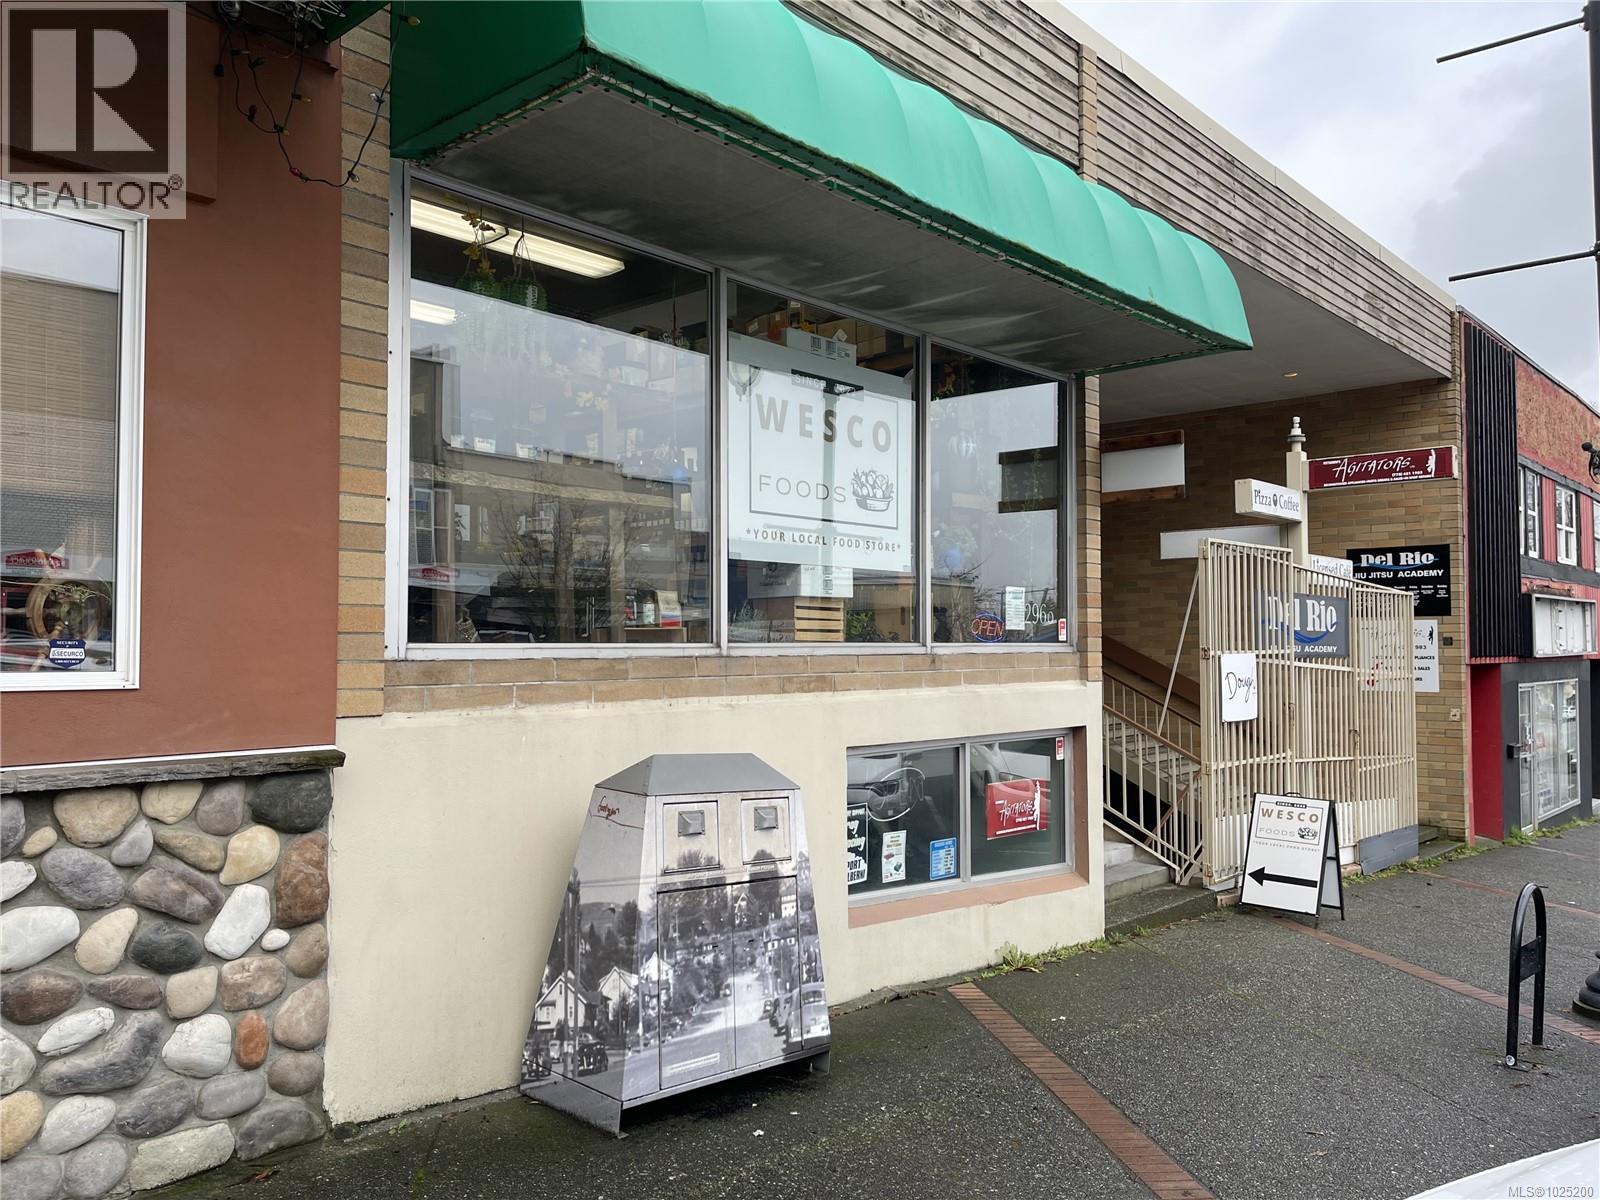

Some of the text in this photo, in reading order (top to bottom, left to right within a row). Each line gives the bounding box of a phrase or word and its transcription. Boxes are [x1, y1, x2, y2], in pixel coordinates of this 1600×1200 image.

[756, 393, 892, 453] WESCO
[759, 474, 847, 503] FOODS
[1254, 489, 1299, 512] Pizza Coffee
[792, 532, 828, 546] LOCAL
[833, 536, 861, 549] FOOD
[1360, 551, 1435, 567] Del Rio
[1368, 571, 1393, 579] JITSU
[1397, 569, 1444, 578] ACADEMY
[1306, 599, 1337, 633] Rio
[971, 618, 1004, 636] OPEN
[1304, 645, 1338, 653] ACADEMY
[1261, 807, 1319, 823] WESCO
[1259, 827, 1295, 837] FOODS
